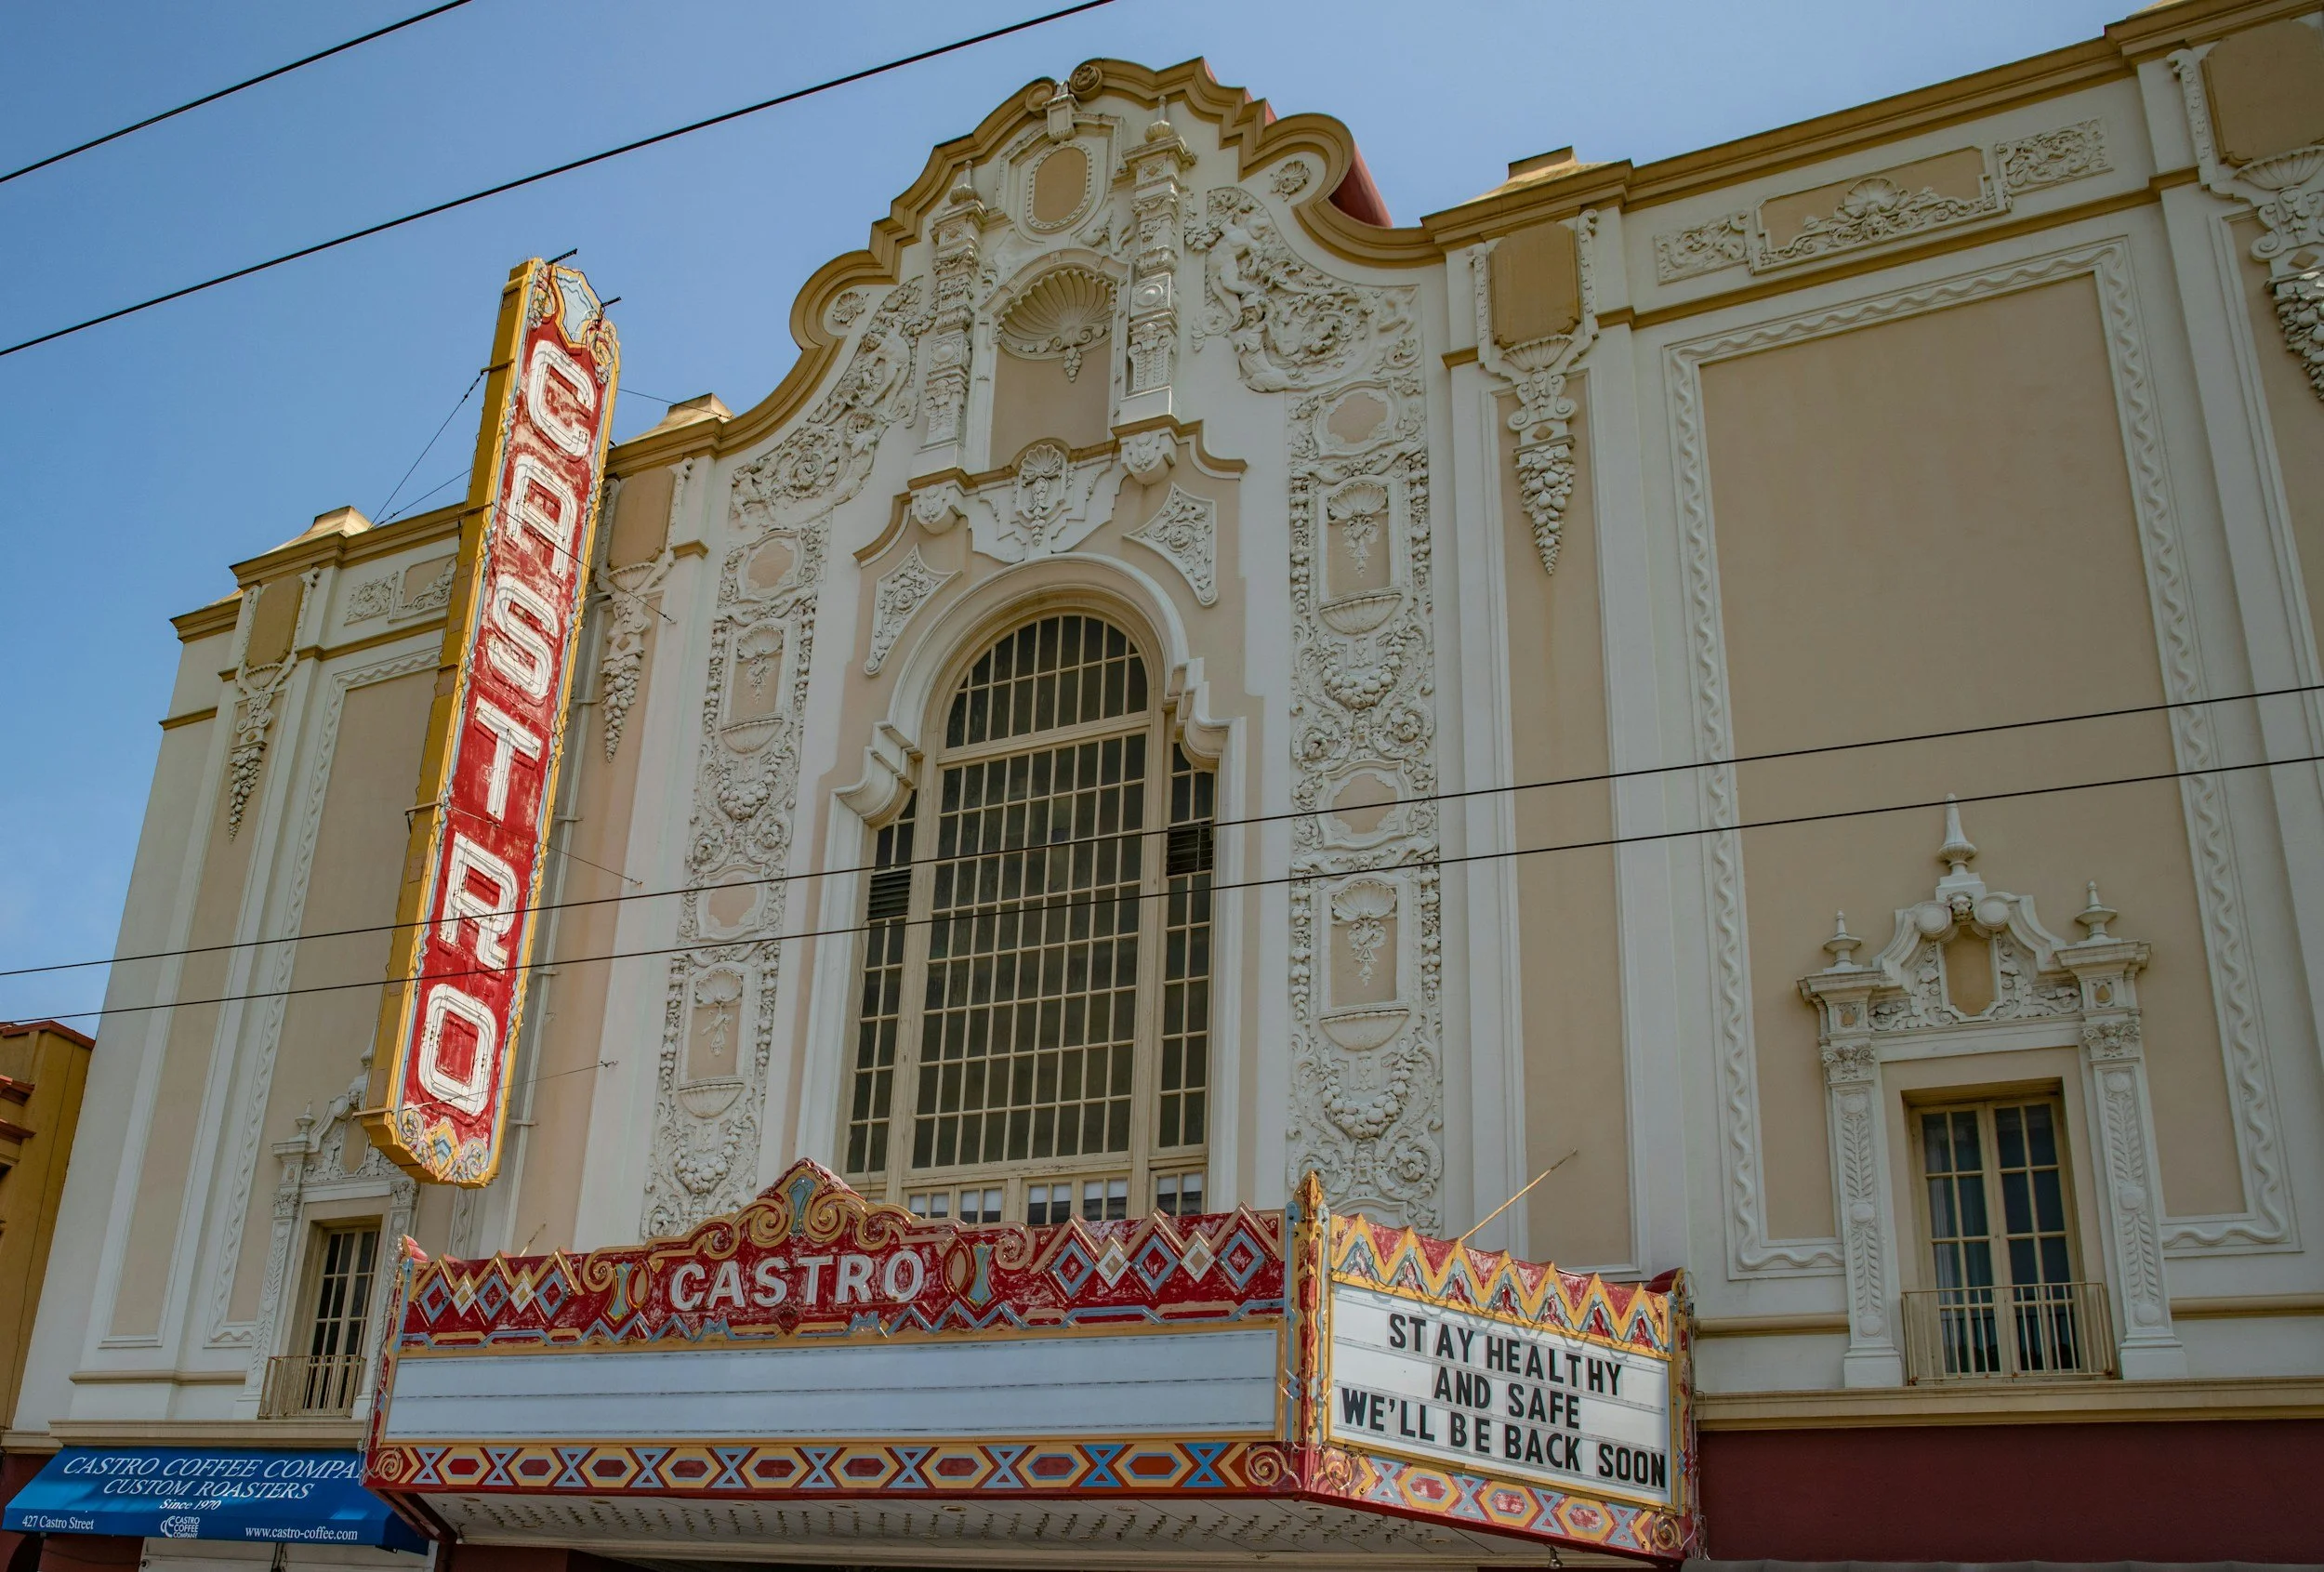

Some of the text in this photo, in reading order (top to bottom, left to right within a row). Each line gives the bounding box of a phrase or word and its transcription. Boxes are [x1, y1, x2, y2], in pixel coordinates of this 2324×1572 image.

[417, 338, 598, 1117] CASTRO
[669, 1249, 925, 1312] CASTRO
[1388, 1313, 1622, 1396] STAY HEALTHY
[1433, 1366, 1580, 1430] AND SAFE
[1340, 1387, 1667, 1488] WE'LL BE BACK SOON
[63, 1457, 161, 1476] CASTRO
[163, 1458, 263, 1477] COFFEE
[103, 1478, 316, 1499] CUSTOM ROASTERS
[159, 1498, 222, 1511] Since 1970
[21, 1515, 94, 1530] 427 Castro Street
[173, 1524, 199, 1533] COFFEE
[175, 1515, 201, 1525] CASTRO
[244, 1526, 358, 1540] www.castro-coffee.com
